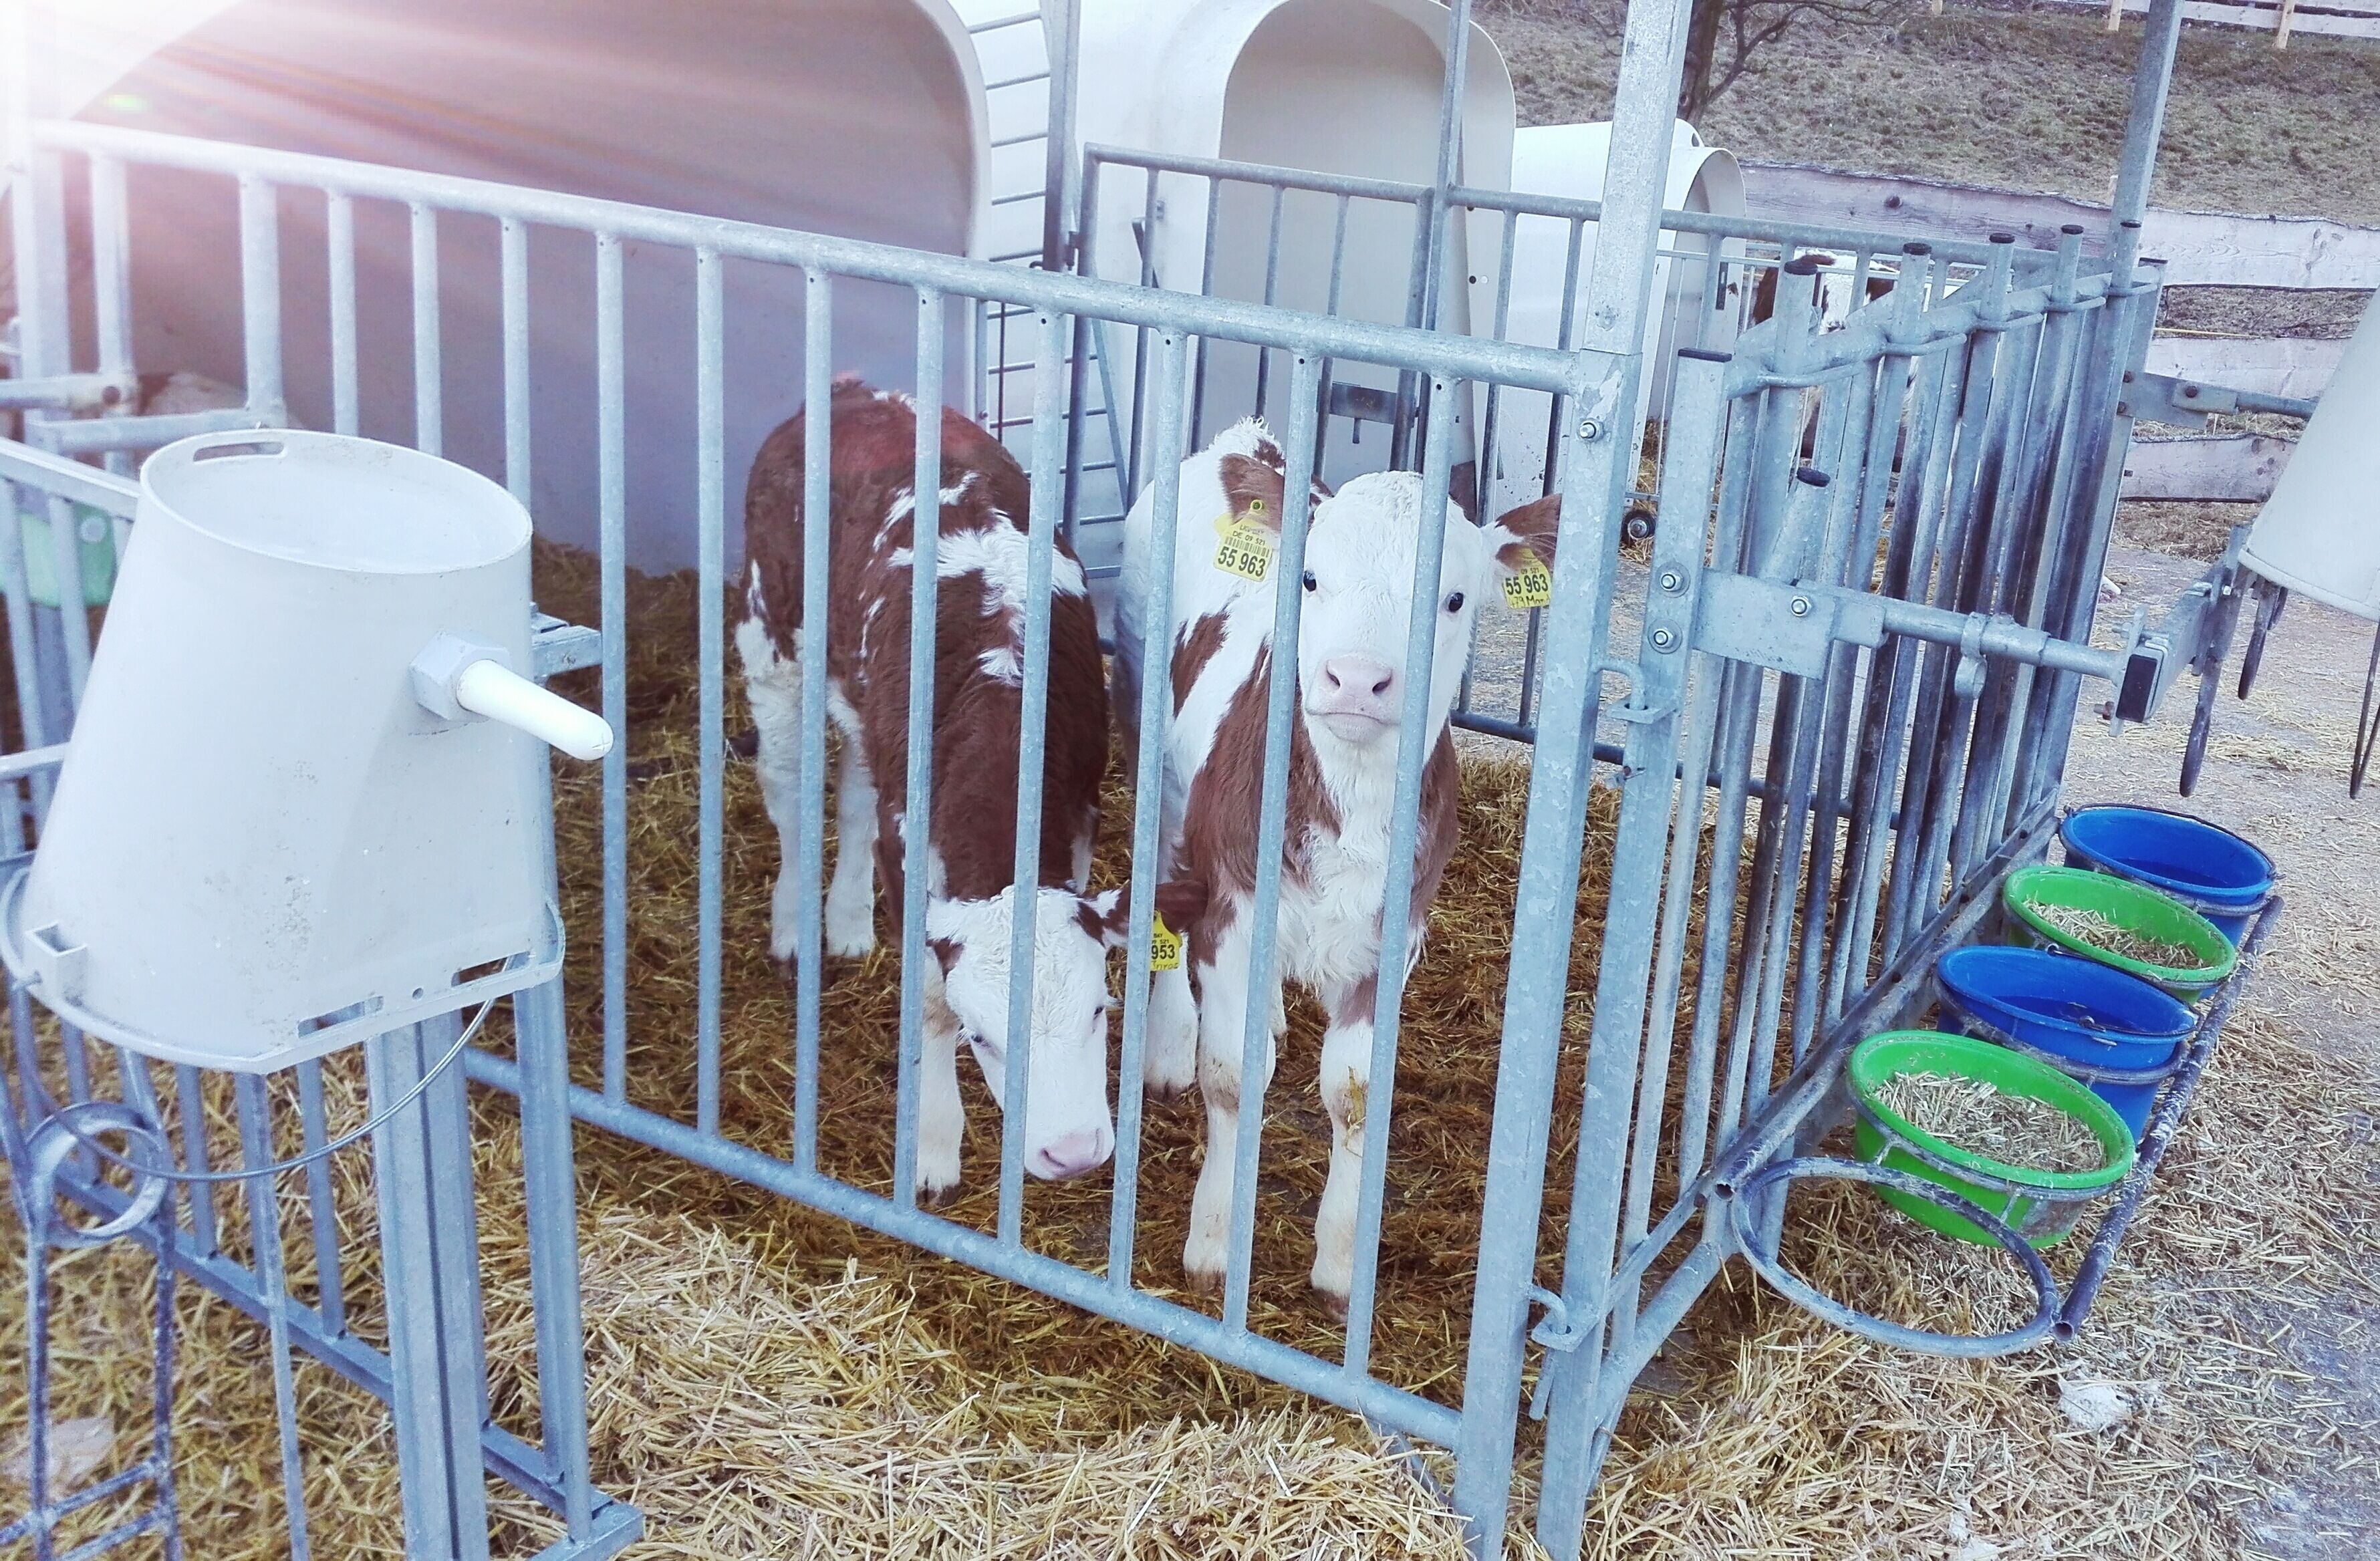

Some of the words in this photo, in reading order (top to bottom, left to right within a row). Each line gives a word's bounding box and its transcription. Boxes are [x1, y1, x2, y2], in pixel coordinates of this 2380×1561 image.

[1232, 531, 1243, 539] DE
[1256, 537, 1265, 546] 521
[1218, 546, 1238, 567] 55
[1238, 552, 1266, 577] 963
[1505, 577, 1522, 595] 55
[1524, 573, 1549, 593] 963
[1151, 944, 1175, 960] 953
